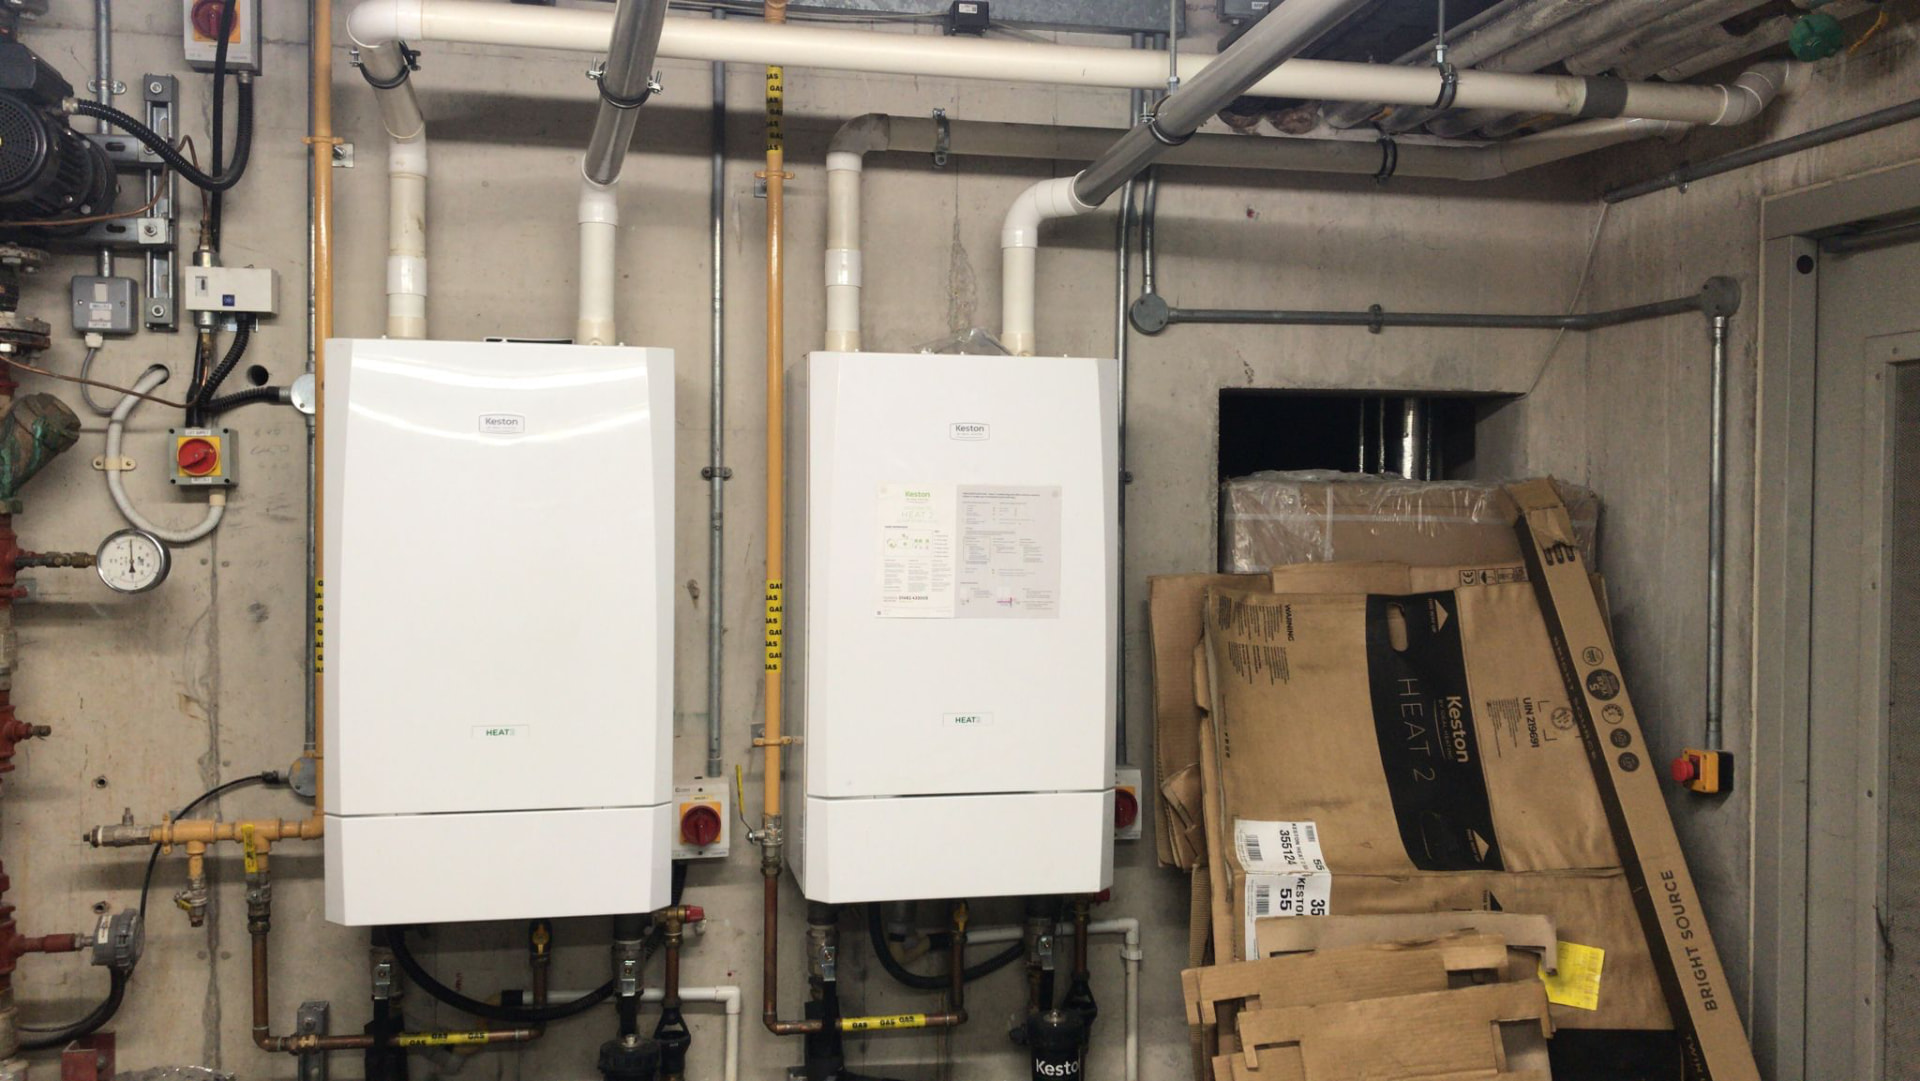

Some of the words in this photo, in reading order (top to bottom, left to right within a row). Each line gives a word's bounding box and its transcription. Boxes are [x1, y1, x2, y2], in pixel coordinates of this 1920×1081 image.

[485, 417, 519, 425] Keston
[955, 424, 985, 432] Keston
[1284, 604, 1295, 642] WARNING
[1589, 682, 1599, 691] 5
[1597, 675, 1610, 695] YEAR
[1397, 678, 1431, 757] HEAT
[1523, 697, 1534, 715] UIN
[1446, 696, 1469, 763] Keston
[1526, 717, 1540, 748] 219691
[1413, 767, 1435, 782] 2
[1279, 829, 1298, 865] 355124
[1292, 823, 1300, 846] KESTON
[1296, 846, 1305, 860] HEAT
[1313, 859, 1325, 870] 55
[1280, 888, 1292, 911] 55
[1661, 870, 1693, 940] SOURCE
[1685, 946, 1718, 1011] BRIGHT
[1036, 1058, 1079, 1076] Kesto
